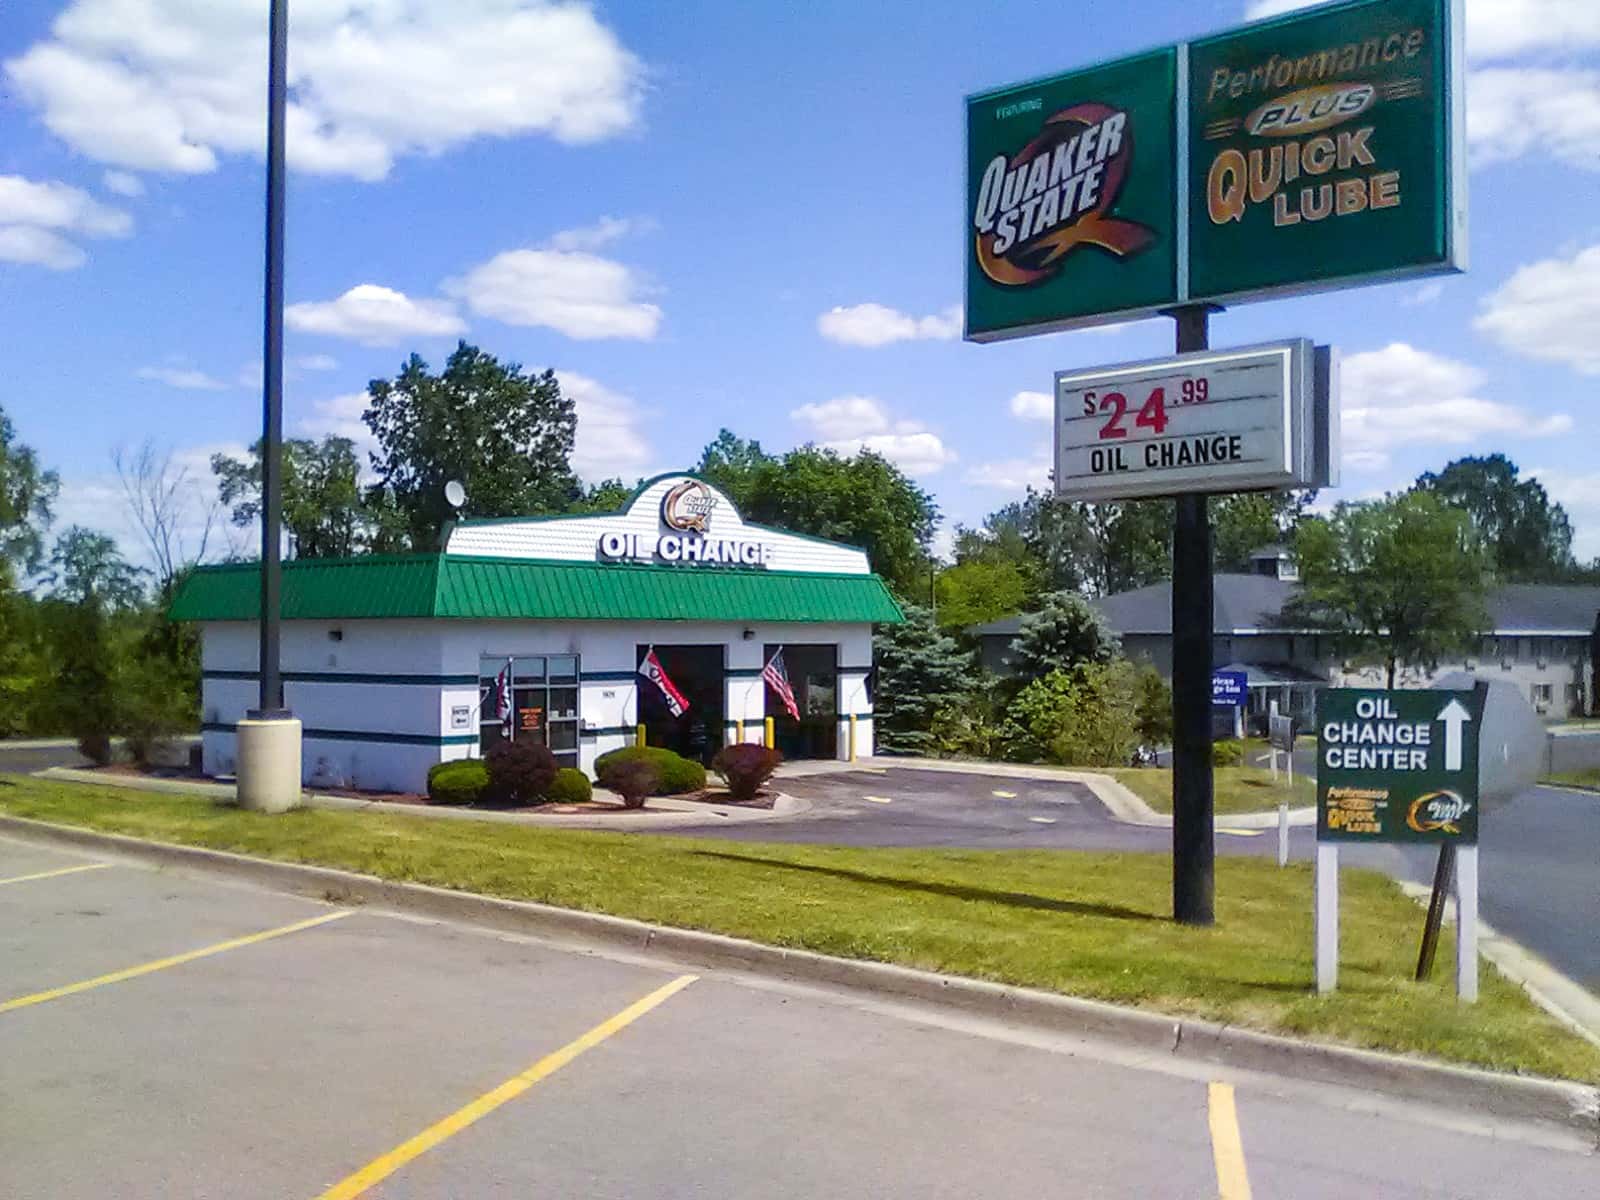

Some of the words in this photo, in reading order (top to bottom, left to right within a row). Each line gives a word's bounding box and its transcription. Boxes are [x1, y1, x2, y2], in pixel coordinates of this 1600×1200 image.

[1206, 27, 1425, 101] Performance
[1254, 83, 1374, 130] PLUS
[974, 111, 1127, 233] QUAKER
[1207, 126, 1377, 225] QUICK
[993, 163, 1106, 257] STATE
[1273, 169, 1401, 228] LUBE
[1090, 449, 1129, 473] OIL
[1144, 436, 1242, 468] CHANGE
[600, 532, 652, 559] OIL
[657, 535, 776, 565] CHANGE
[1356, 698, 1398, 719] OIL
[1323, 722, 1431, 745] CHANGE
[1325, 748, 1427, 770] CENTER
